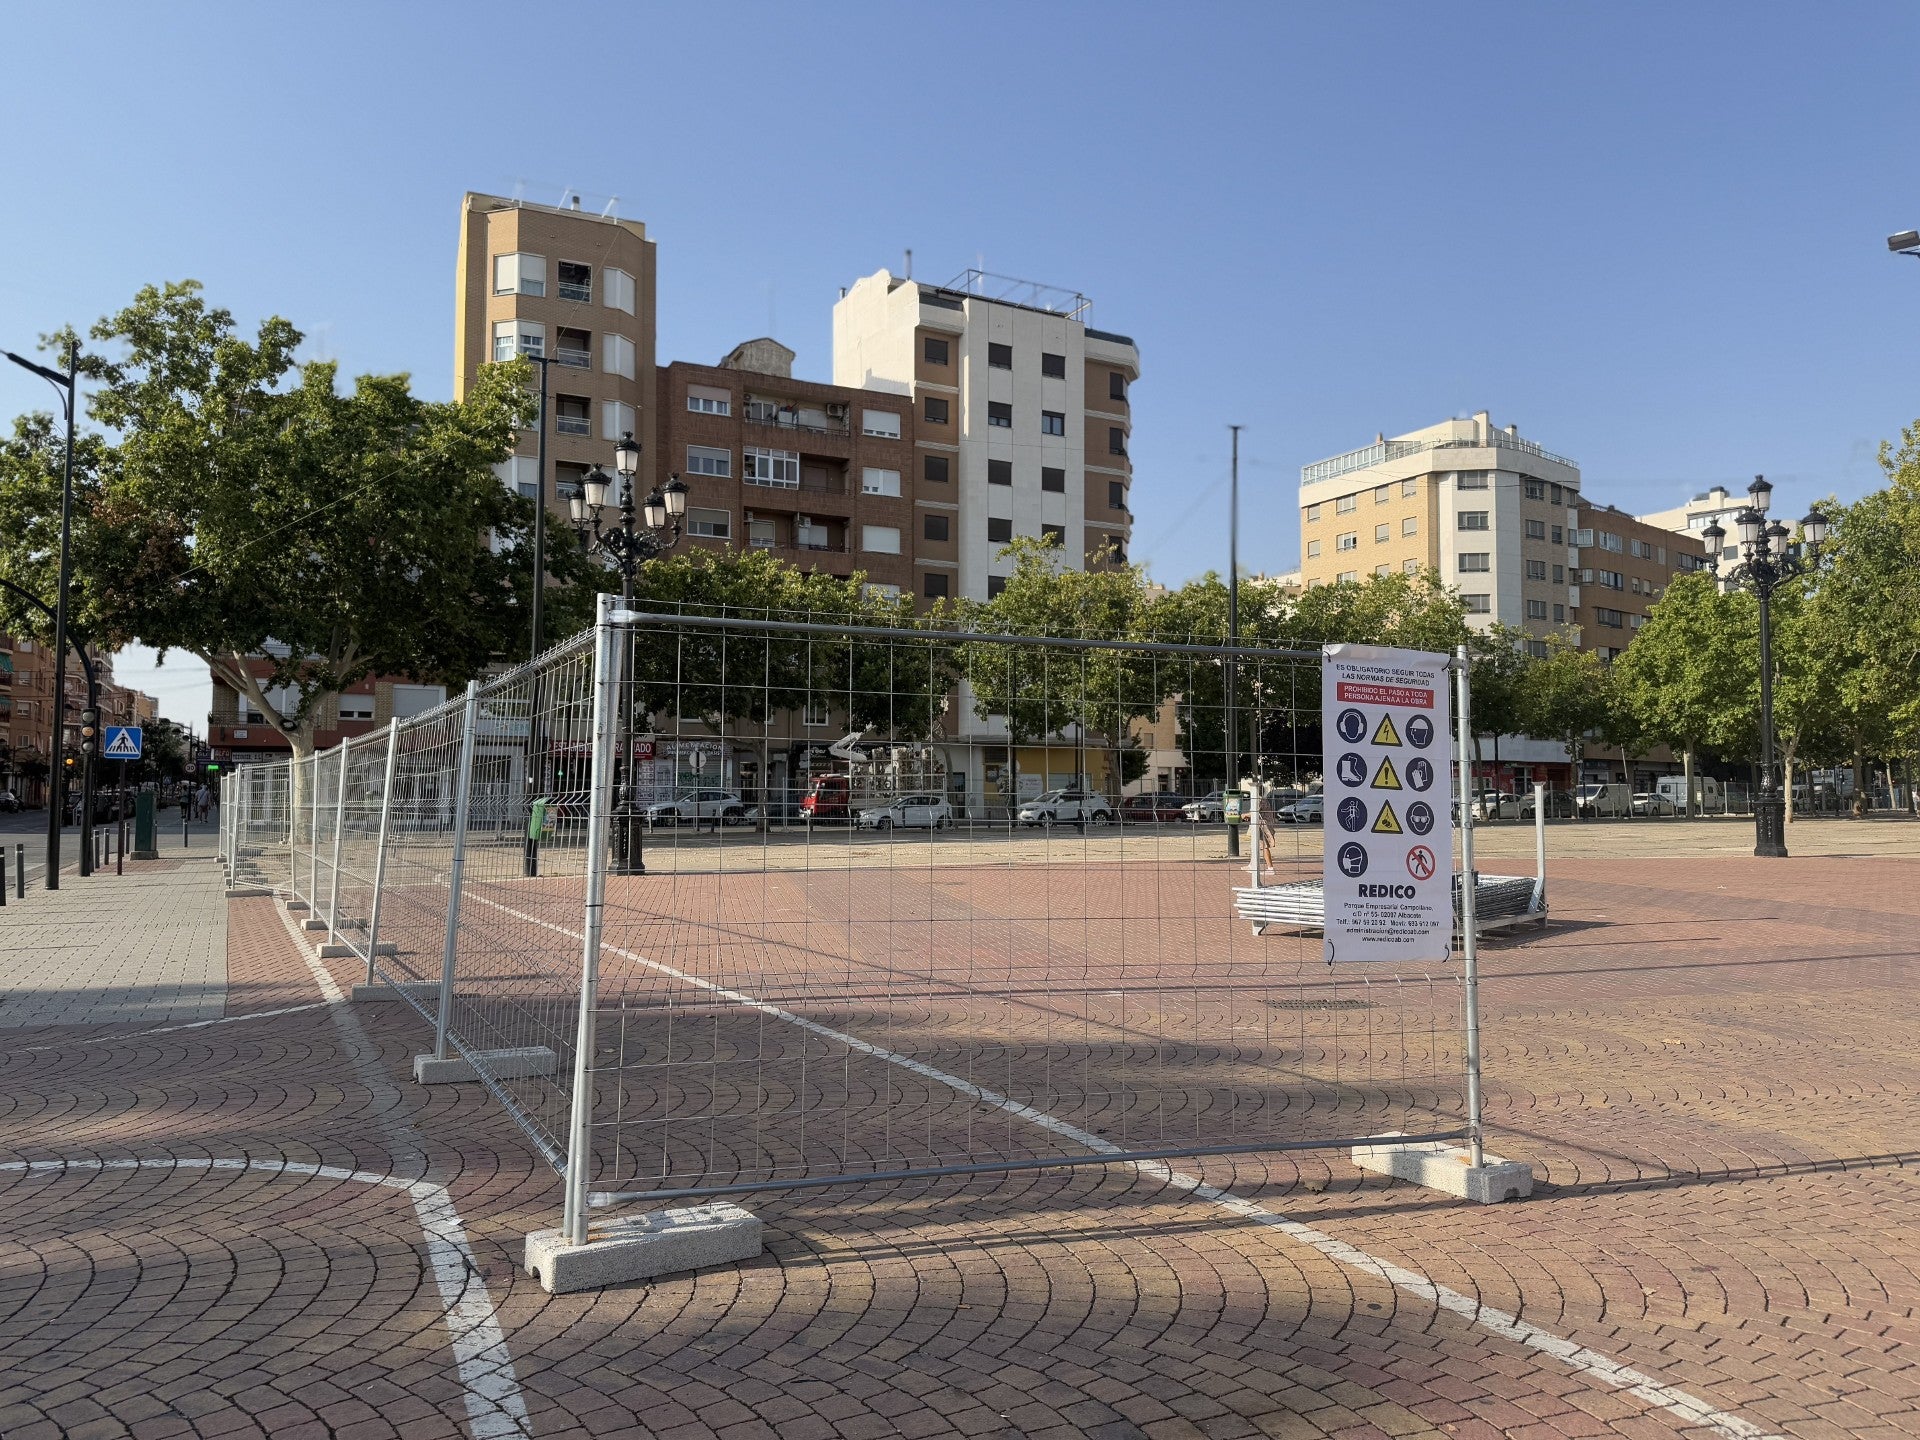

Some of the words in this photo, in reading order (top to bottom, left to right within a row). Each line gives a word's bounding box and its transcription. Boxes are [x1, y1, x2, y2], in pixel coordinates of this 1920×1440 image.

[1346, 664, 1390, 675] OBLIGATORIO
[1391, 669, 1415, 677] SEGUIR
[1416, 671, 1435, 679] TODAS
[1342, 672, 1355, 680] LAS
[1356, 674, 1384, 682] NORMAS
[1395, 677, 1430, 686] SEGURIDAD
[1344, 685, 1378, 694] PROHIBIDO
[1389, 689, 1404, 697] PASO
[1411, 690, 1428, 698] TODA
[1344, 692, 1374, 701] PERSONA
[1358, 884, 1416, 899] REDICO
